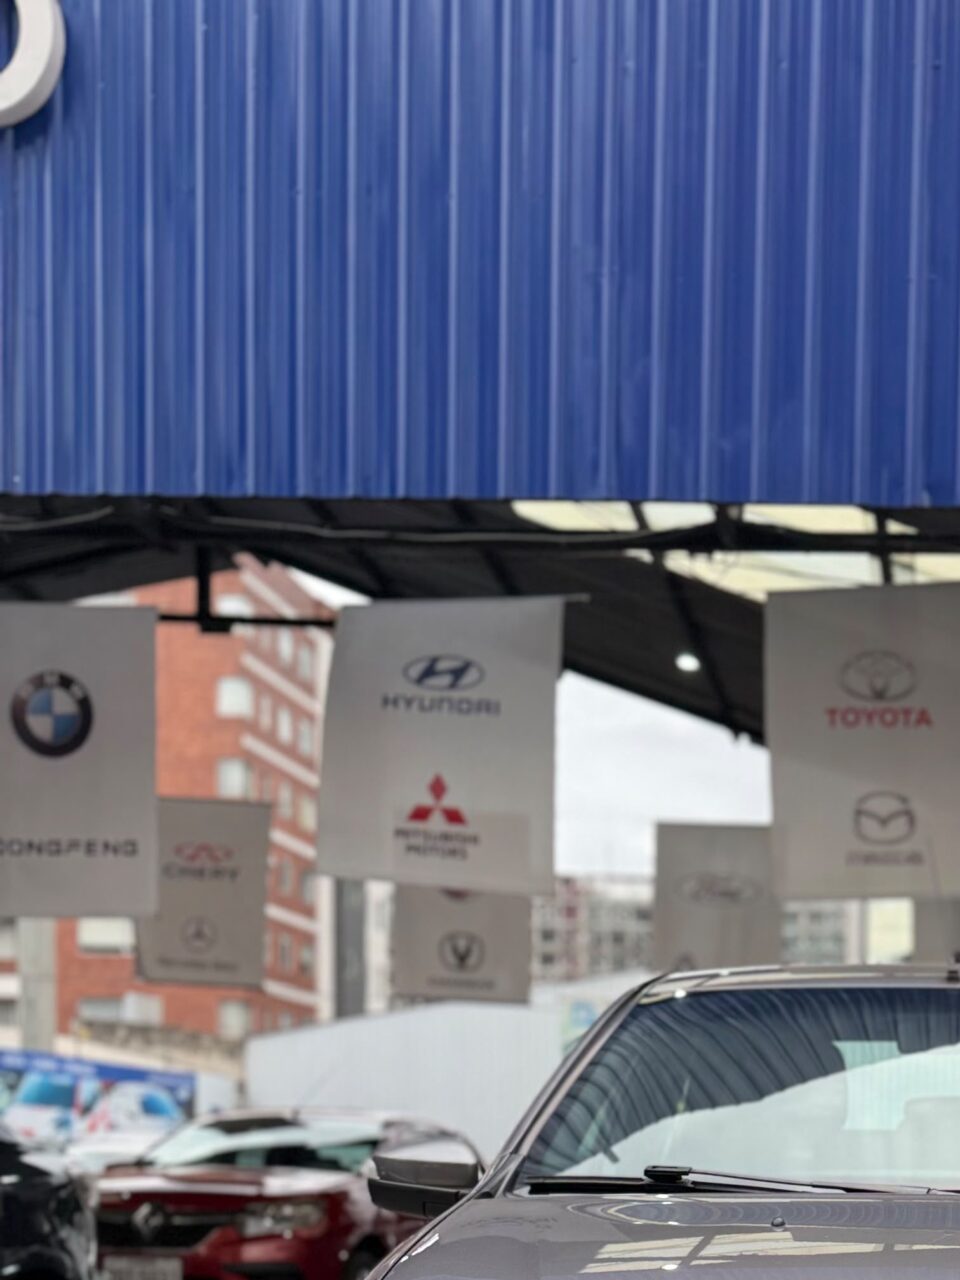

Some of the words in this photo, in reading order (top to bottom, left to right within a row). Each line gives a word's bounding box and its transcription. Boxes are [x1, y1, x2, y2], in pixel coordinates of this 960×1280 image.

[381, 693, 501, 717] HYUNDAI
[826, 706, 933, 729] TOYOTA
[0, 837, 138, 857] ONGFENG
